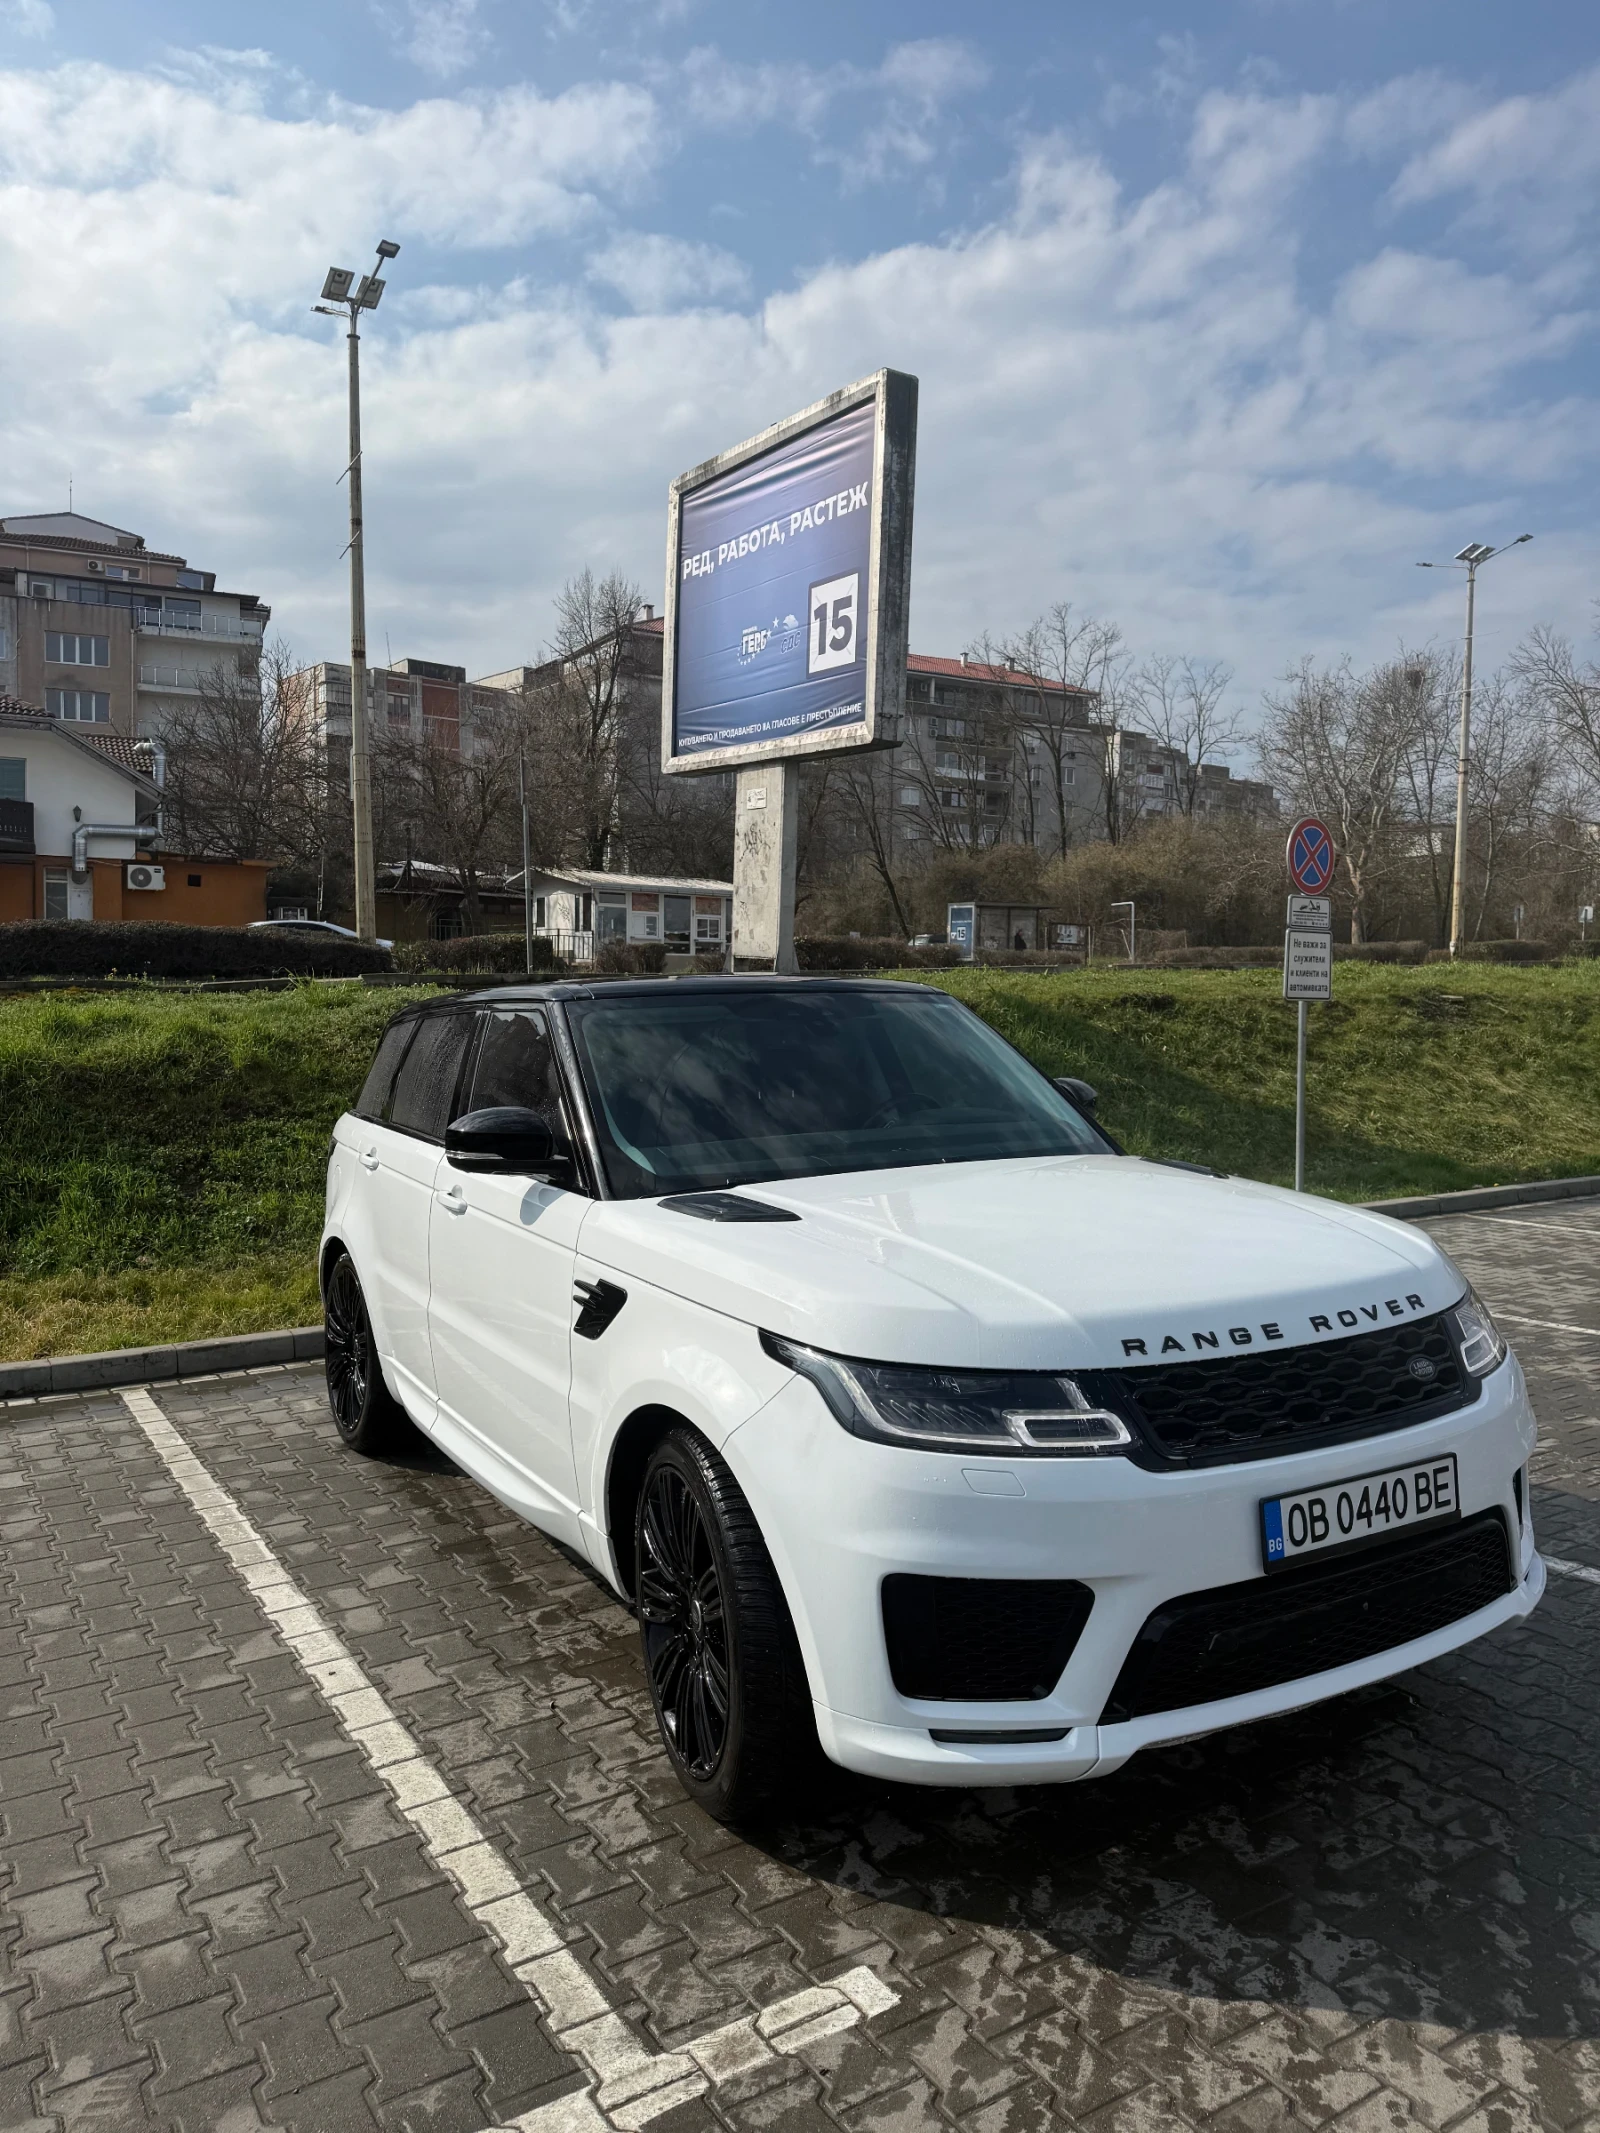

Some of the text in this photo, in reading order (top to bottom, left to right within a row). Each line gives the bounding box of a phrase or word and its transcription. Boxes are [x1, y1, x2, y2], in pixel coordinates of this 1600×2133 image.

[683, 481, 869, 580] РЕД, РАБОТА, РАСТЕЖ
[813, 594, 852, 656] 15
[742, 629, 767, 656] ГЕРБ
[780, 630, 801, 655] СДС
[678, 732, 714, 747] КУПУВАНЕТО
[713, 731, 719, 741] И
[719, 723, 762, 739] ПРОДАВАНЕТО
[771, 714, 801, 730] ГЛАСОВЕ
[801, 713, 807, 724] Е
[806, 702, 863, 722] ПРЕСТЪПЛЕНИЕ
[957, 929, 966, 939] 15
[1293, 938, 1327, 950] Не важи за
[1293, 954, 1326, 965] служители
[1295, 969, 1320, 978] клиенти
[1320, 970, 1328, 979] на
[1289, 983, 1329, 993] автомивката
[1121, 1293, 1426, 1357] RANGE ROVER
[1288, 1465, 1452, 1548] OB 0440 BE
[1268, 1537, 1283, 1553] BG
